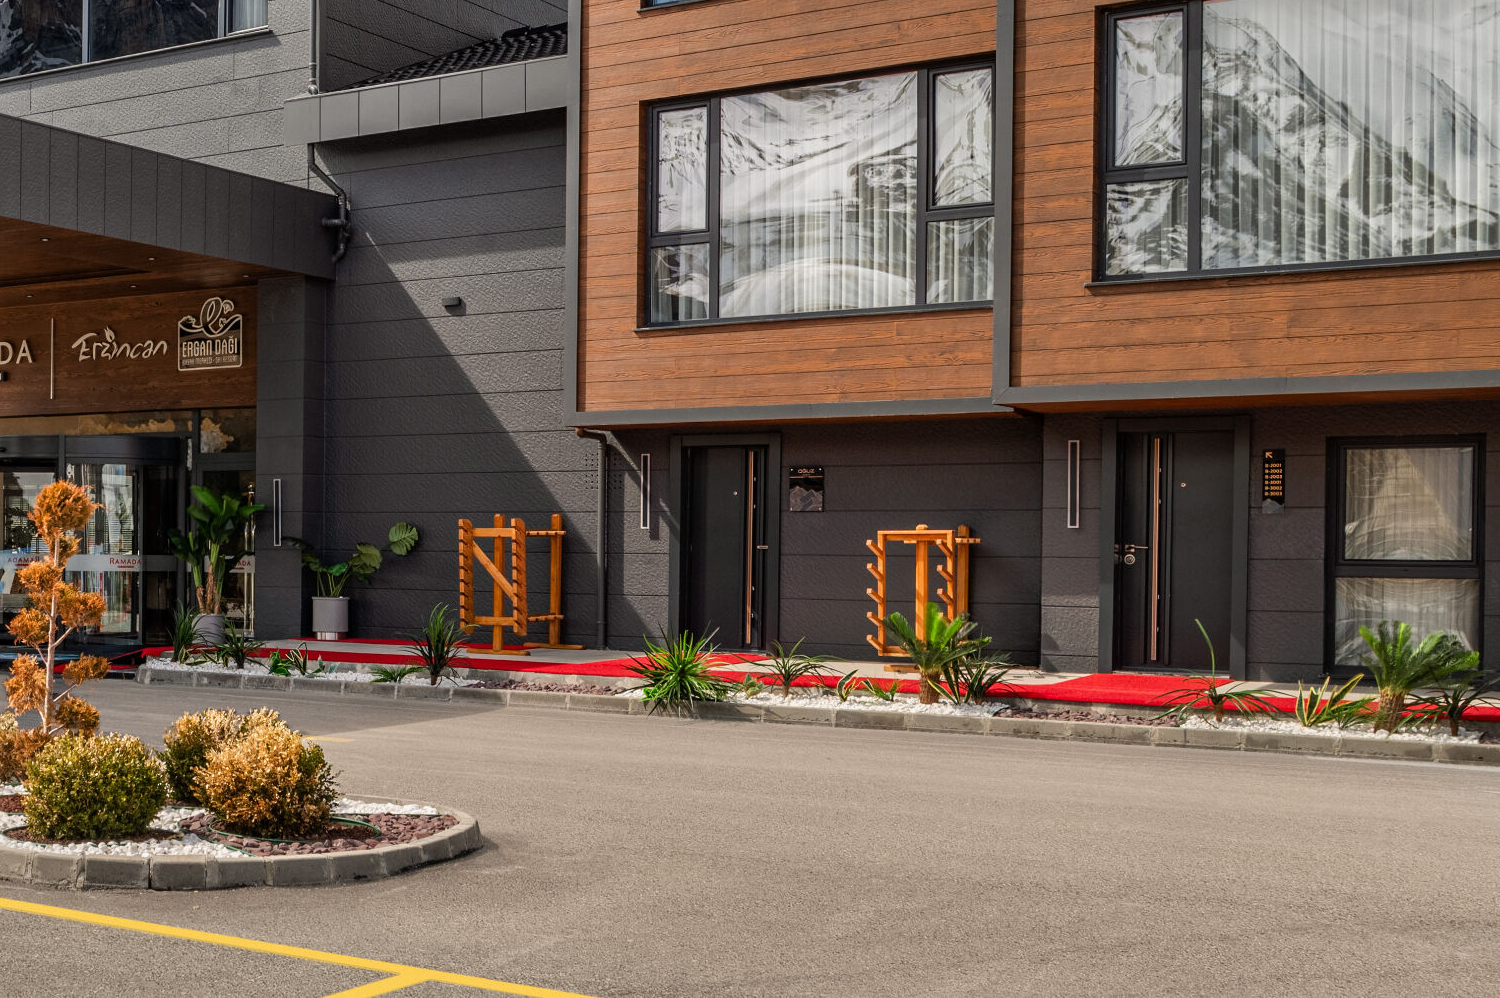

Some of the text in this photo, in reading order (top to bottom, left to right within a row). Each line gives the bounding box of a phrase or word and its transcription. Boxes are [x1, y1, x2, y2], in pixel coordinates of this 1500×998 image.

[71, 326, 168, 362] Erzincan
[182, 335, 238, 357] ERGAN DAĞI
